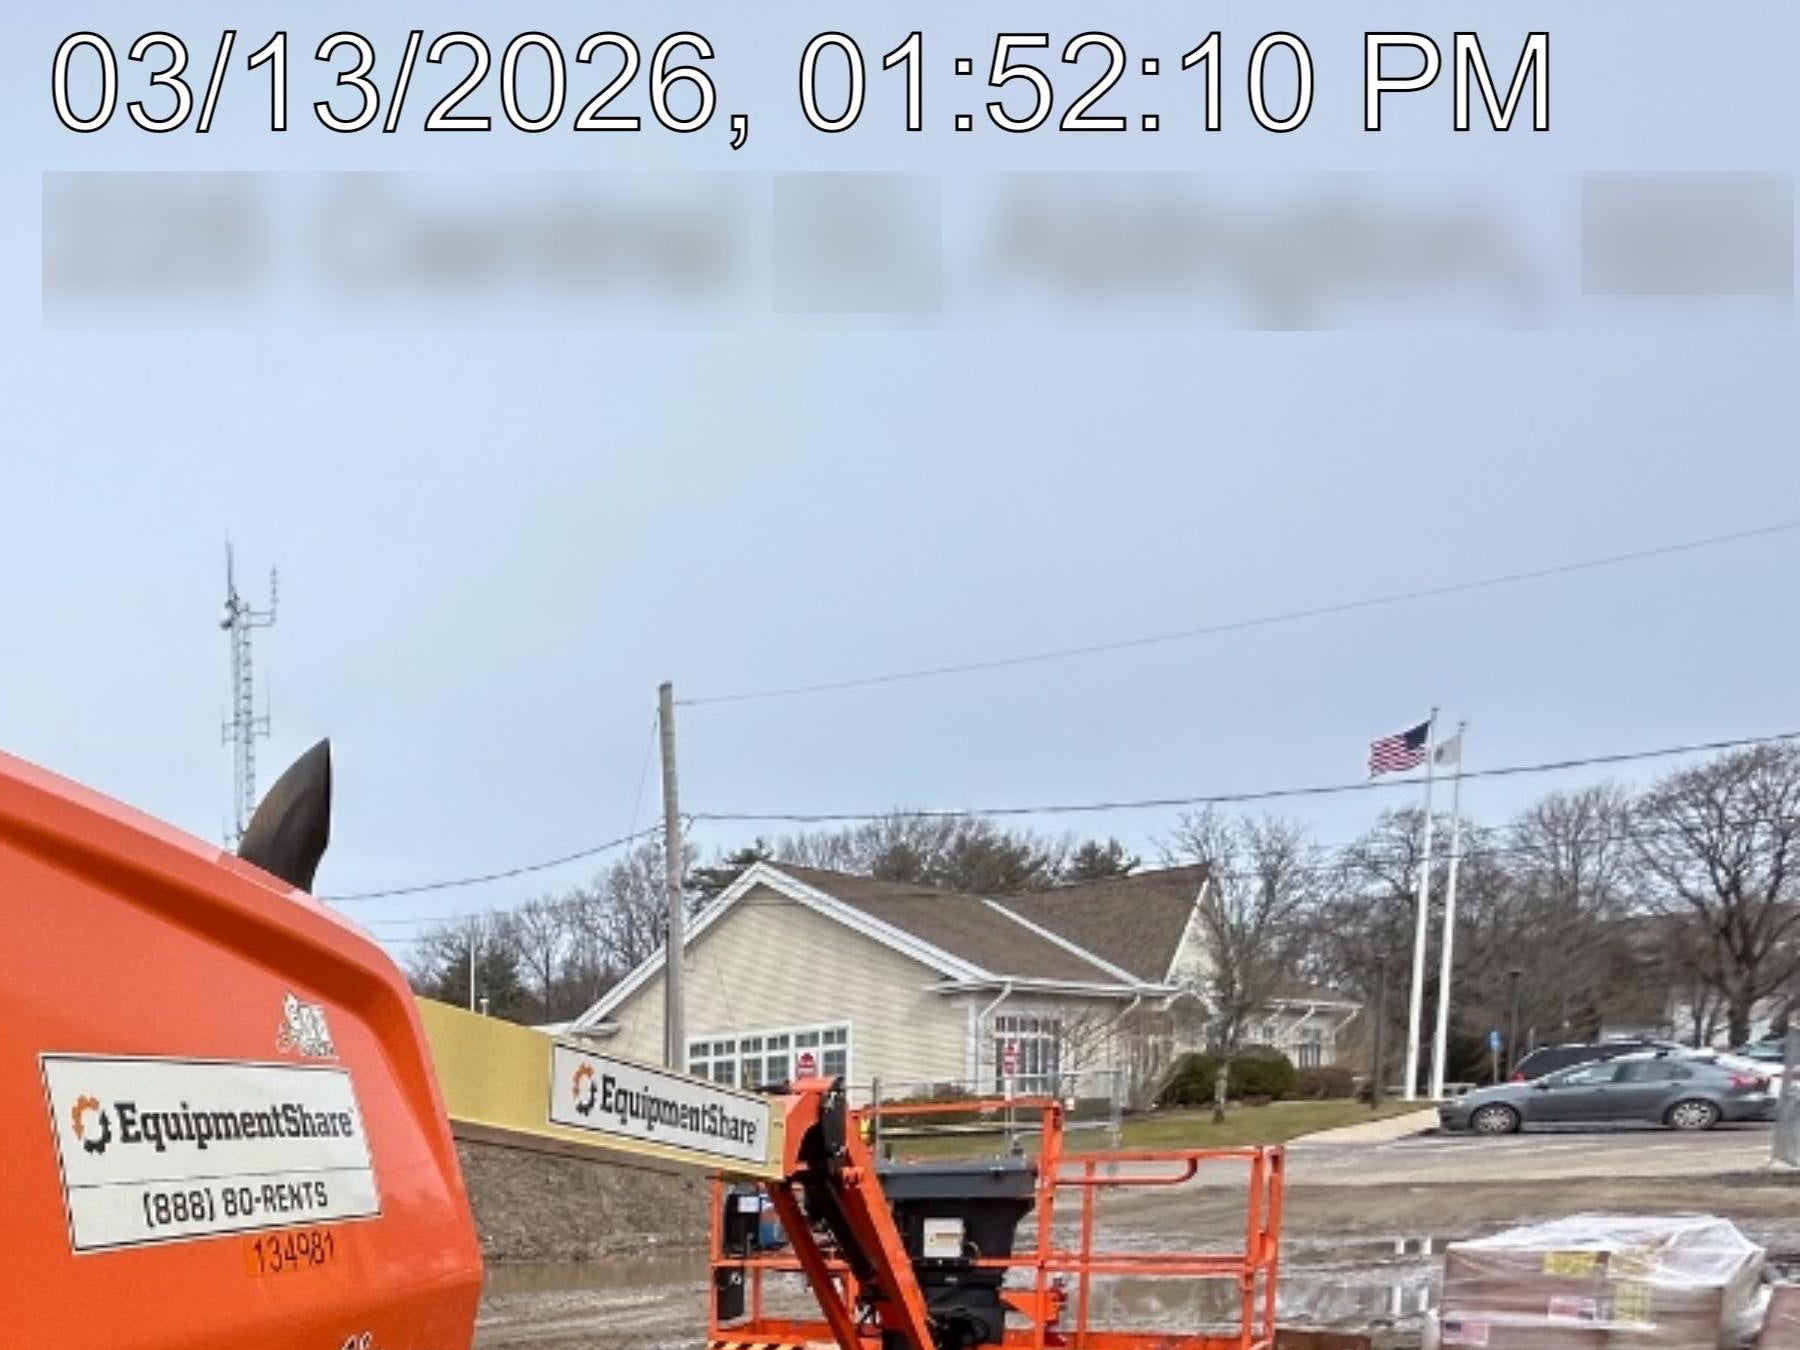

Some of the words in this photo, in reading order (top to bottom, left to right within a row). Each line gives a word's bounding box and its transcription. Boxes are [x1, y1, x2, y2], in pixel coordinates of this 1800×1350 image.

[113, 1100, 352, 1152] EquipmentShare
[600, 1073, 757, 1145] EquipmentShare
[143, 1187, 215, 1228] (888)
[222, 1181, 329, 1219] 80-RENTS
[253, 1230, 335, 1274] 134981
